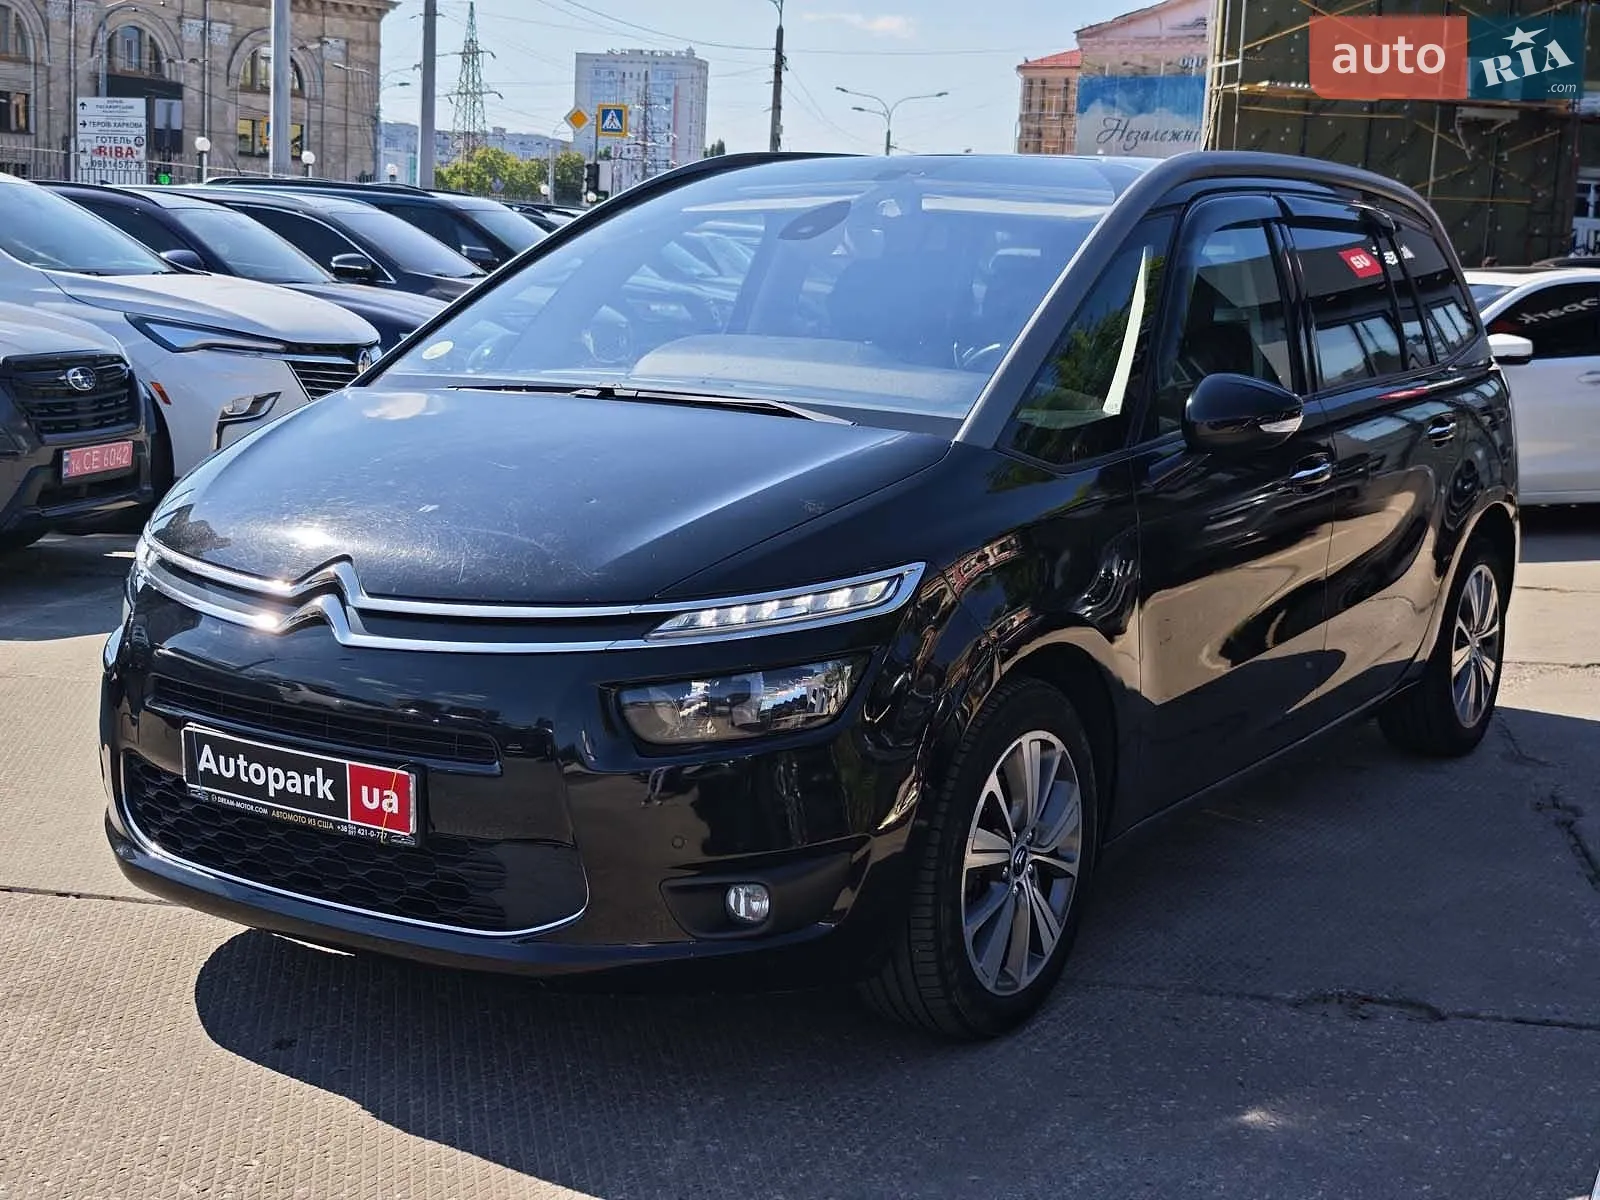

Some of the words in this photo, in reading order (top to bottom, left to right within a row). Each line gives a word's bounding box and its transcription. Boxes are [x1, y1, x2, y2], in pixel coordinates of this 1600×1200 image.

[95, 136, 132, 145] ГОТЕЛЬ
[83, 450, 100, 470] CE
[103, 446, 129, 467] 6042
[198, 743, 335, 802] Autopark
[361, 785, 399, 814] ua
[218, 795, 269, 816] DREAM-MOTOR.COM
[271, 810, 307, 825] АВТОМОТО
[307, 818, 317, 826] ИЗ
[317, 819, 334, 830] США
